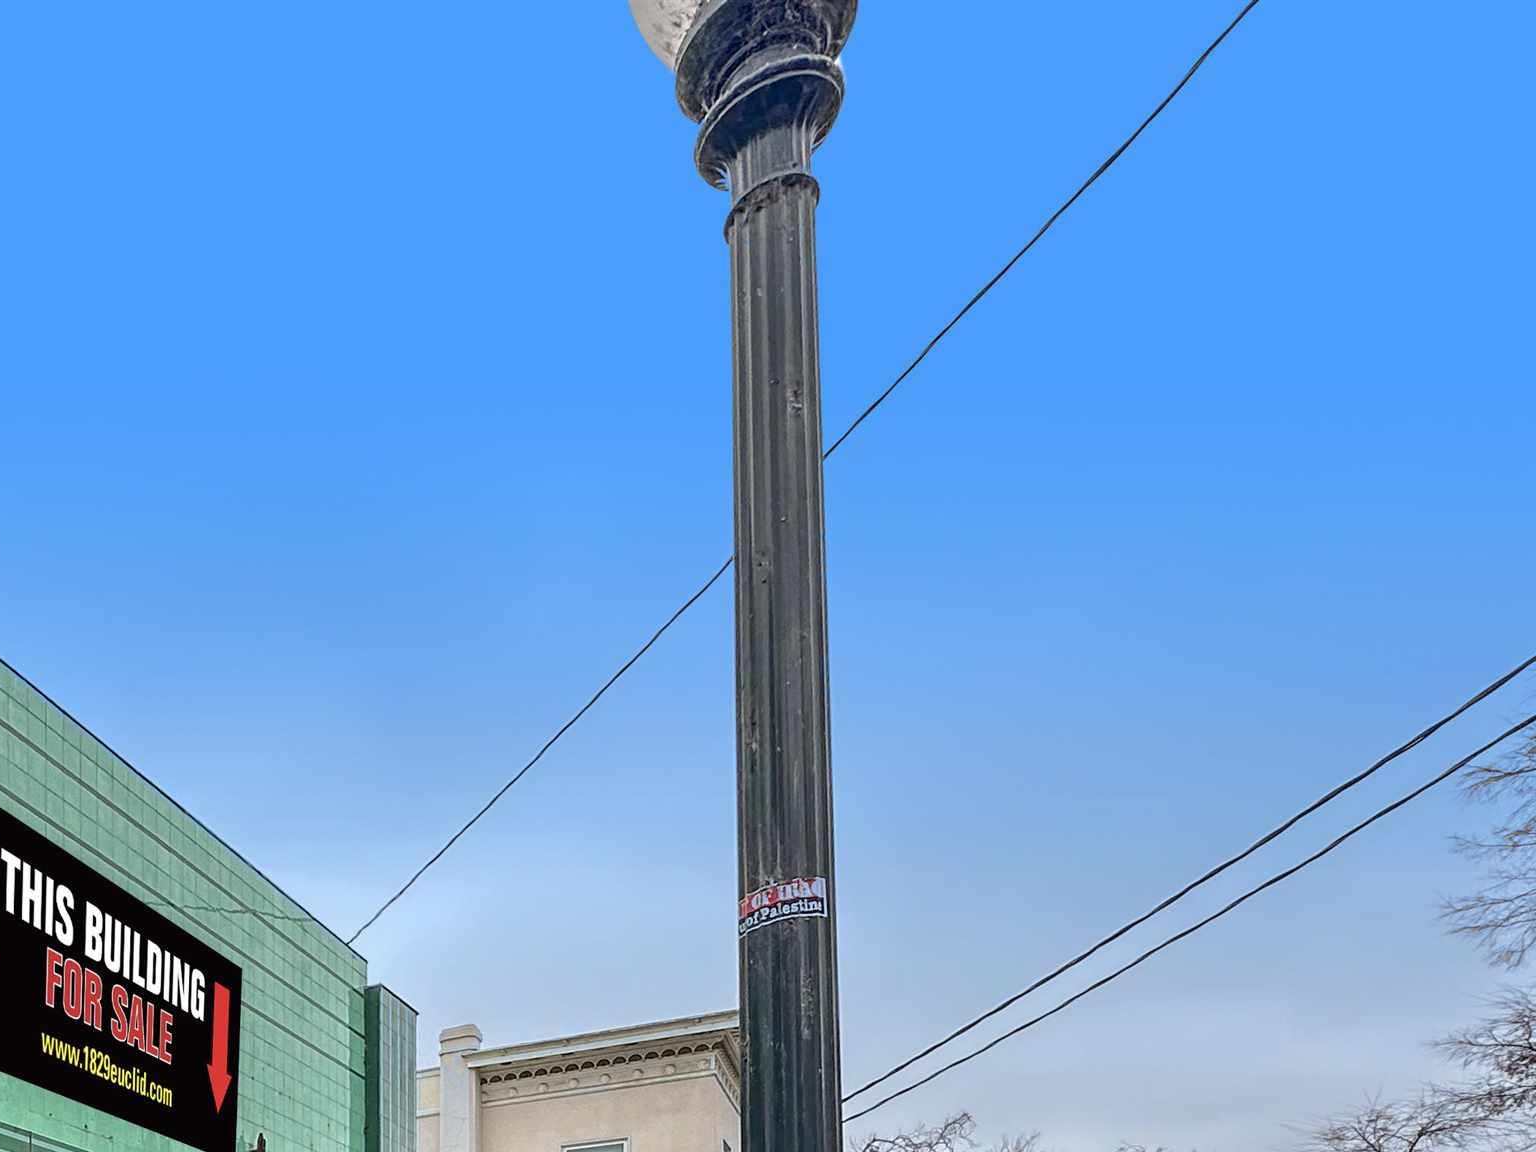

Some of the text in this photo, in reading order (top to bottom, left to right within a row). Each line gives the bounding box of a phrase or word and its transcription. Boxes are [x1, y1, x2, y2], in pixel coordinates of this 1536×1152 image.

[0, 847, 206, 1022] THIS BUILDING
[45, 946, 174, 1065] FOR SALE
[41, 1032, 173, 1108] www.1829euclid.com
